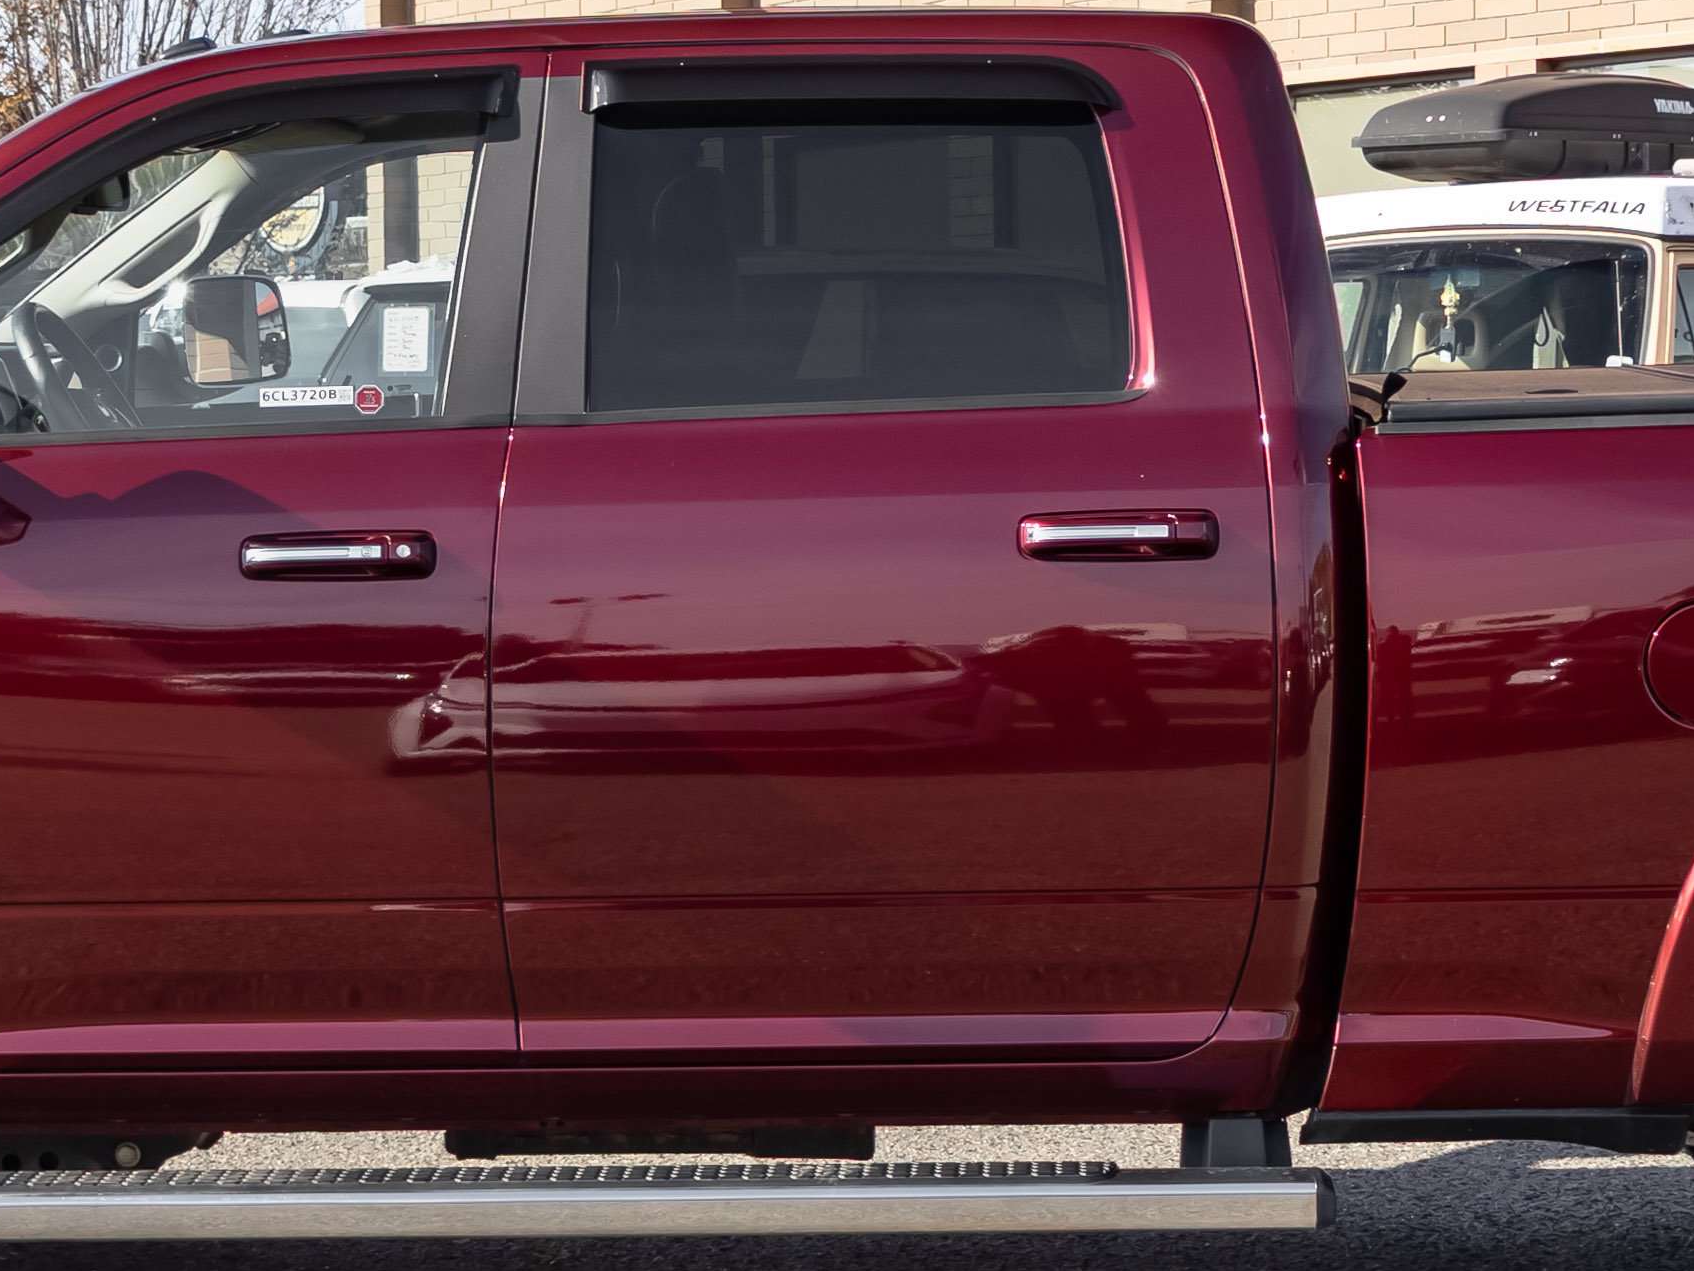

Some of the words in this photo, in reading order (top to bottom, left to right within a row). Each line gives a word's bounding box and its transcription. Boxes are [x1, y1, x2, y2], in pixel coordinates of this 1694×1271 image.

[1653, 97, 1693, 115] YAKIMA
[1508, 199, 1646, 216] WESTFALIA
[262, 389, 337, 402] 6CL3720B
